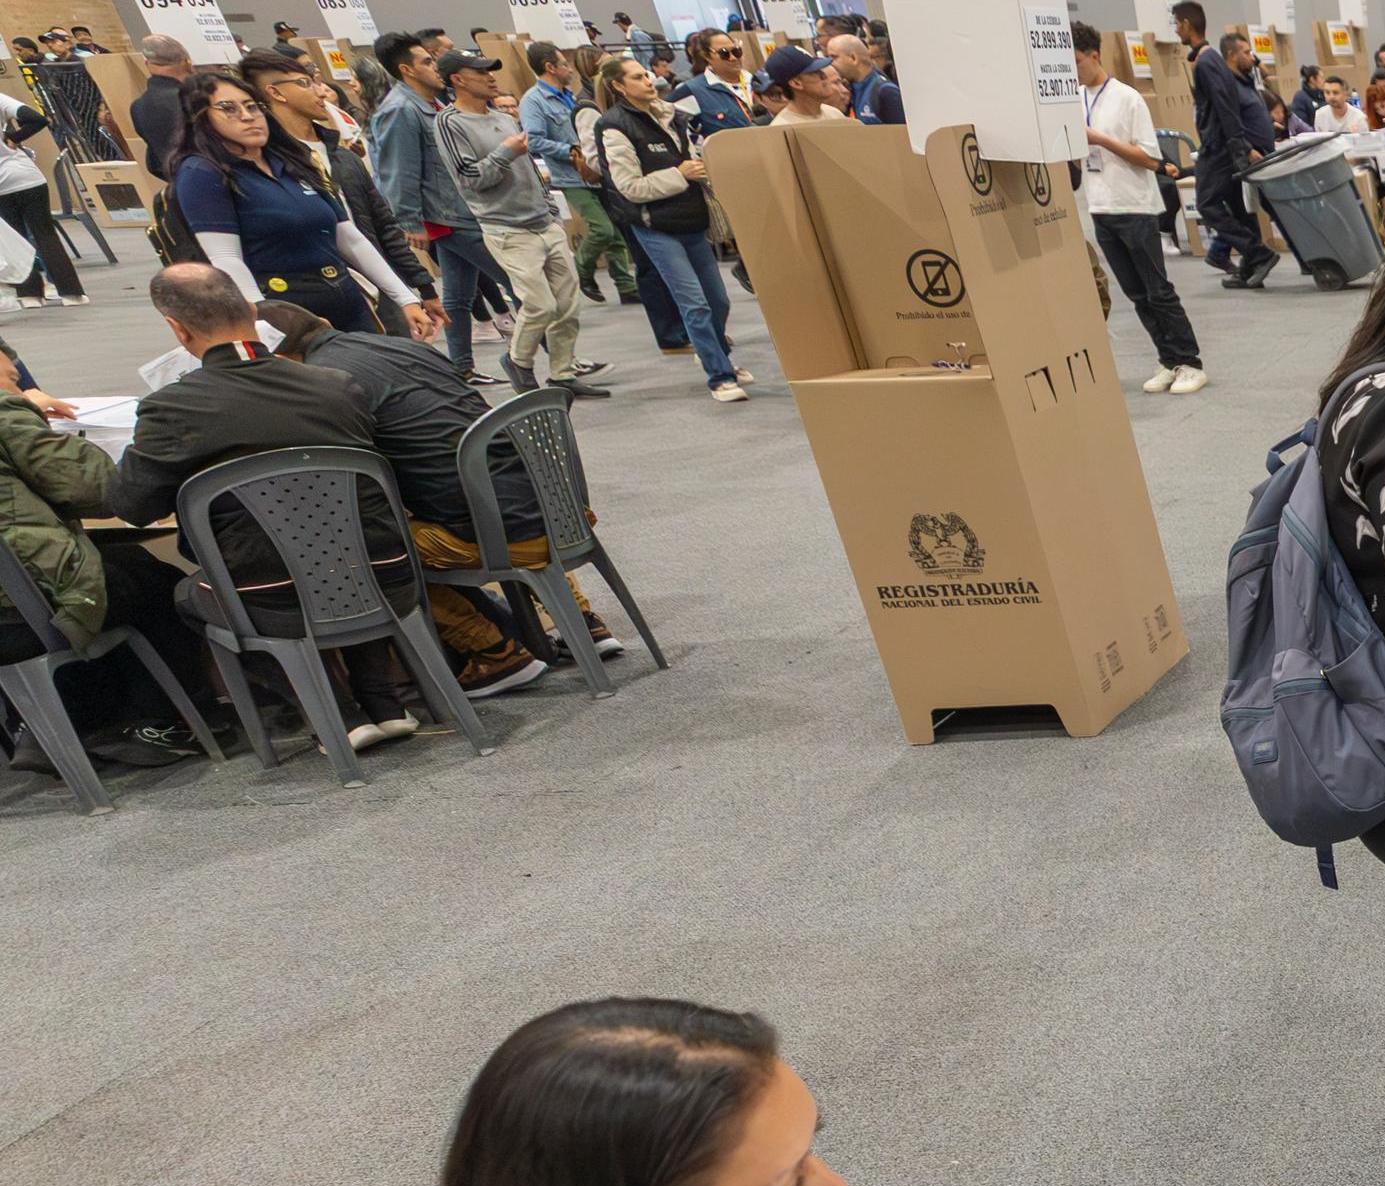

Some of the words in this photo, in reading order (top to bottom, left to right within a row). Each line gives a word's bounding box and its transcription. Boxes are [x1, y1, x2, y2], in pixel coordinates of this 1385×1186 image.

[1030, 31, 1071, 49] 52.899.390
[1038, 78, 1079, 97] 52.907.172
[877, 578, 1039, 599] REGISTRADURÍA
[881, 598, 939, 609] NACIONAL
[942, 597, 964, 607] DEL
[967, 596, 1010, 606] ESTADO
[1013, 595, 1042, 605] CIVIL
